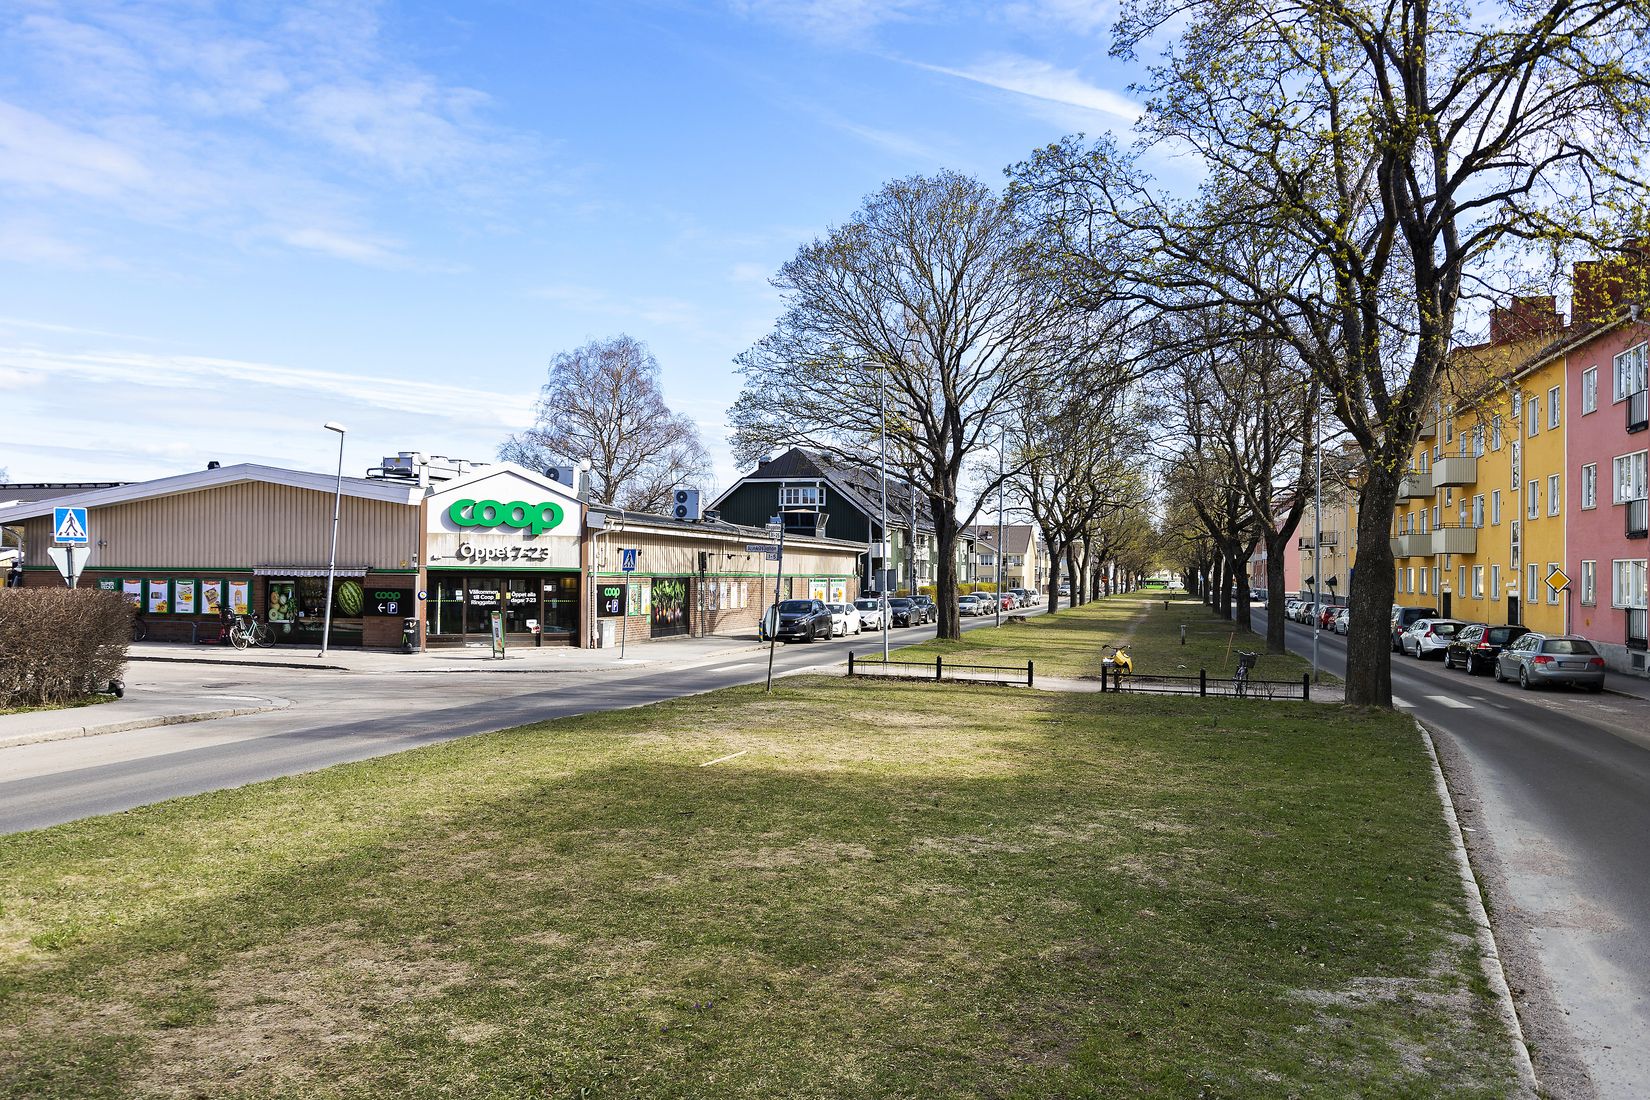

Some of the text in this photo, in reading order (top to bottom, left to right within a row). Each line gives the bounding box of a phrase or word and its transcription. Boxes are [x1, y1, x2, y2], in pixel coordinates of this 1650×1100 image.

[450, 499, 564, 534] coop
[461, 541, 551, 560] Öppet 7-23
[375, 592, 400, 601] coop
[605, 588, 620, 598] coop
